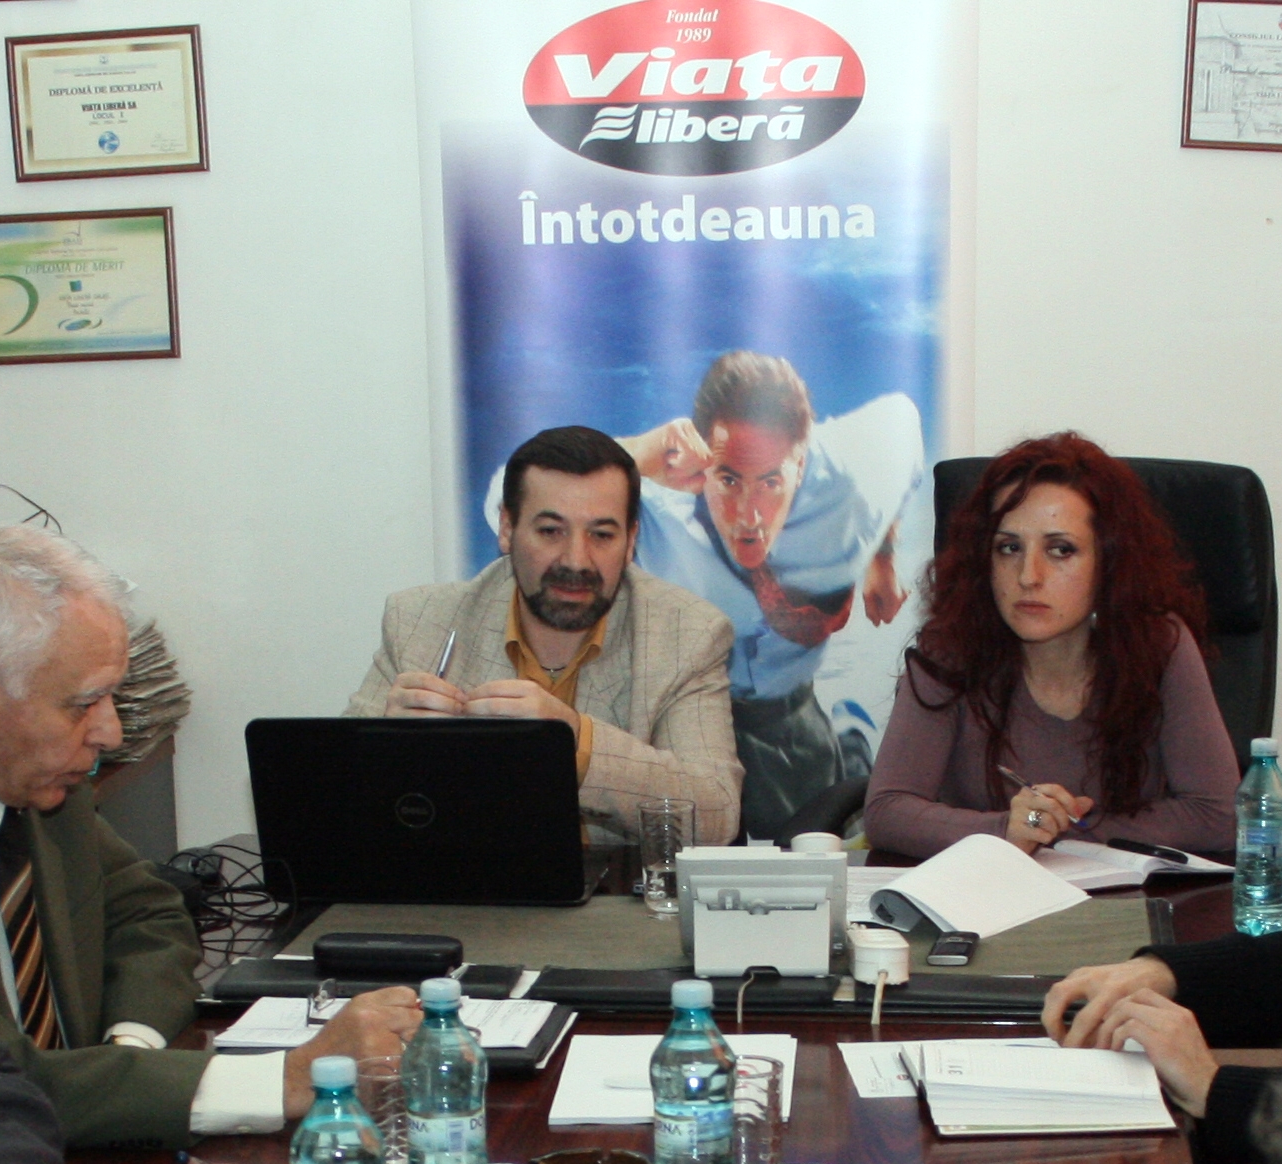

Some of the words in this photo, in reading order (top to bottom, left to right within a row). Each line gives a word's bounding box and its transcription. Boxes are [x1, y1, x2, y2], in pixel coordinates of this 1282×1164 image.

[666, 8, 720, 24] Fondat
[675, 27, 713, 43] 1989
[518, 190, 876, 245] Întotdeauna
